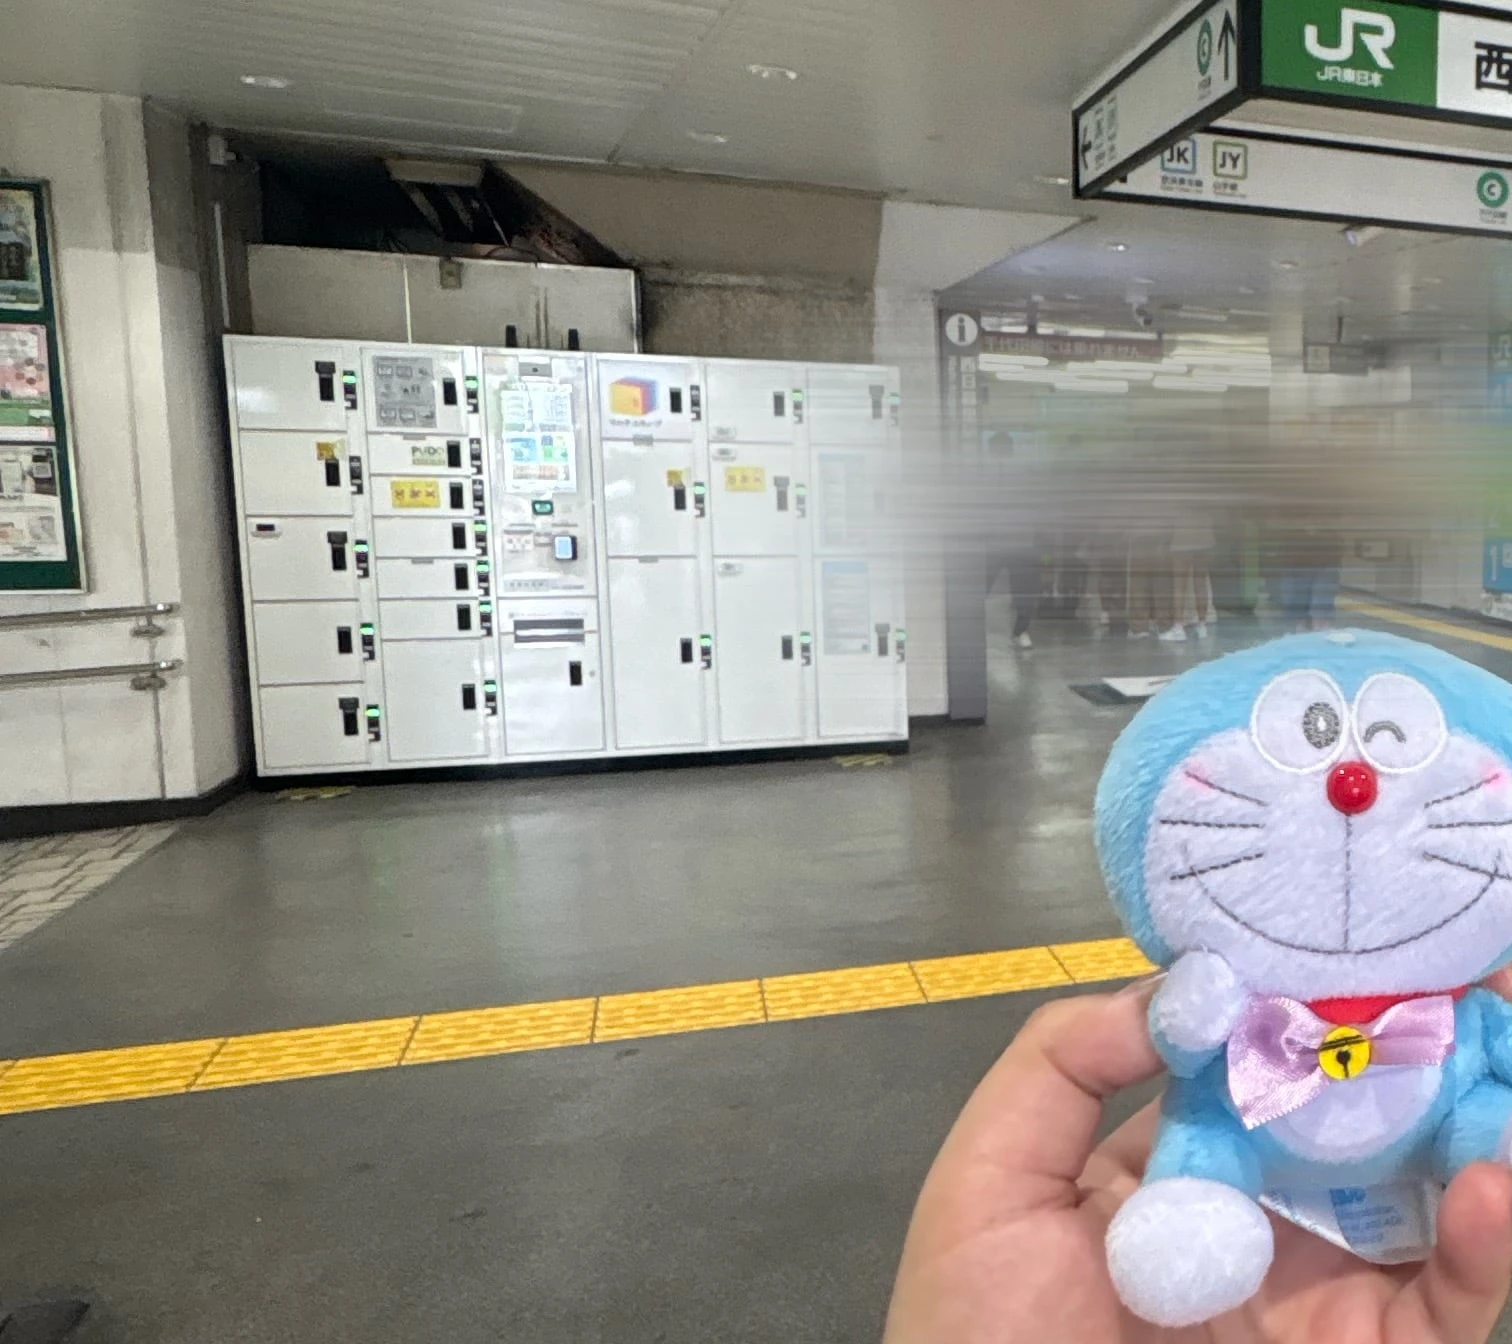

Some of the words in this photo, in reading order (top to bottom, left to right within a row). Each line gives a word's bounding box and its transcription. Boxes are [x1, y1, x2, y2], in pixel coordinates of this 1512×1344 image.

[1304, 8, 1396, 70] JR
[1167, 145, 1189, 164] JK
[1219, 151, 1240, 169] JY
[1487, 183, 1497, 197] C
